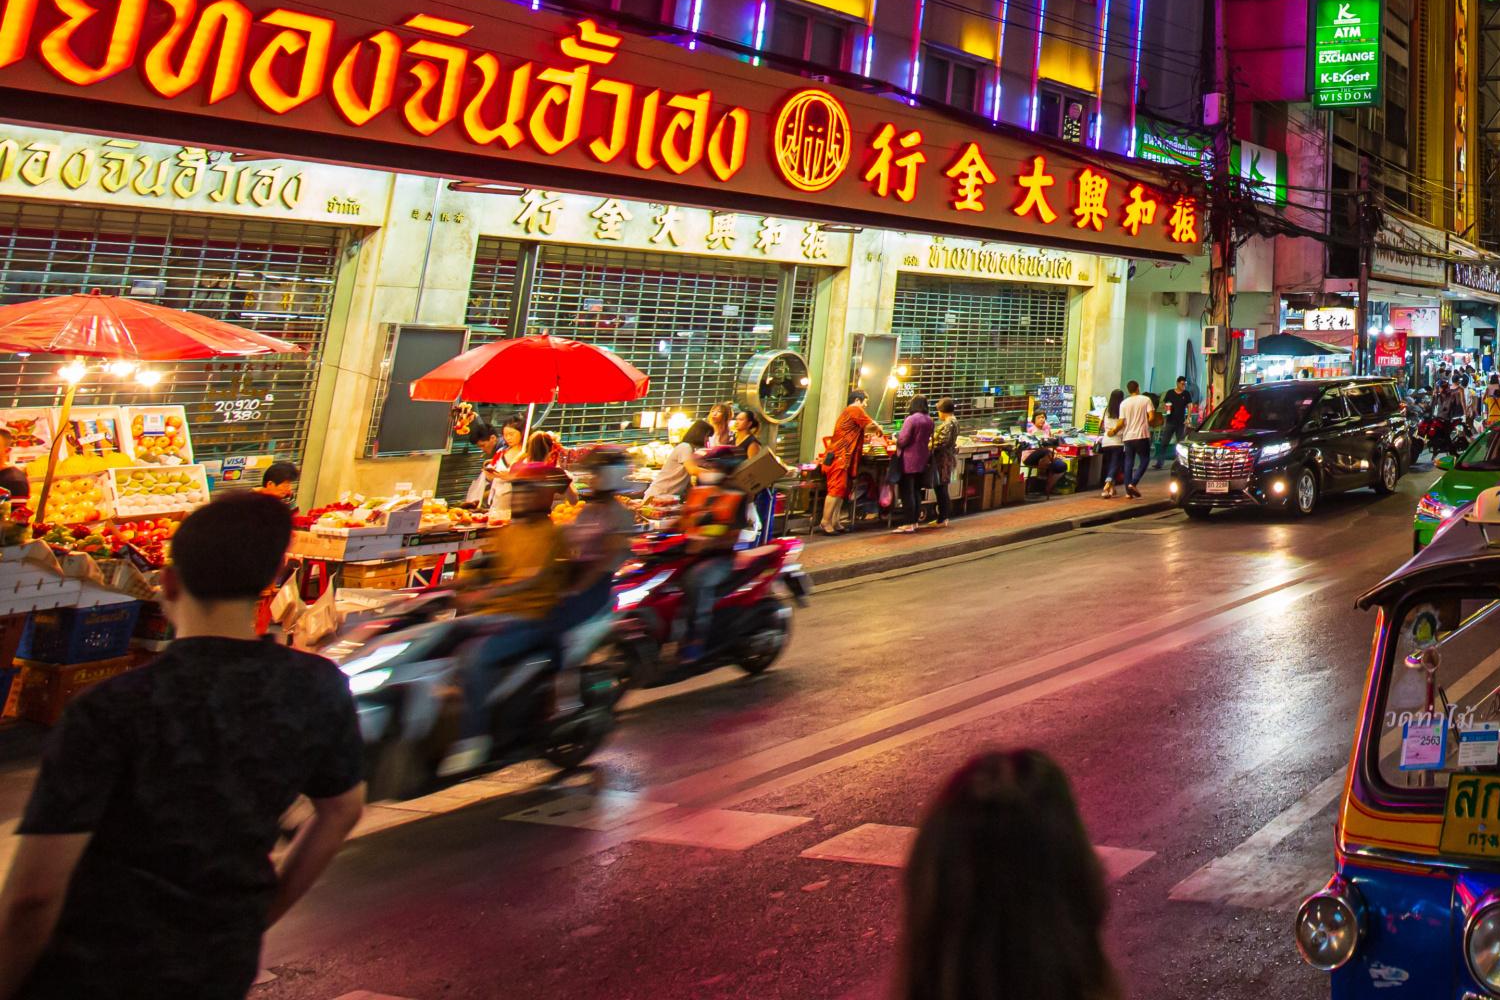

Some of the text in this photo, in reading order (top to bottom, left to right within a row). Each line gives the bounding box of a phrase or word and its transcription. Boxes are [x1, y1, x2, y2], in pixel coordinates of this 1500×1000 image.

[1334, 27, 1361, 39] ATM
[1319, 52, 1375, 64] EXCHANGE
[1321, 69, 1370, 85] K-Expert
[1320, 91, 1372, 102] WISDOM
[226, 457, 245, 466] VISA
[1420, 736, 1441, 746] 2563
